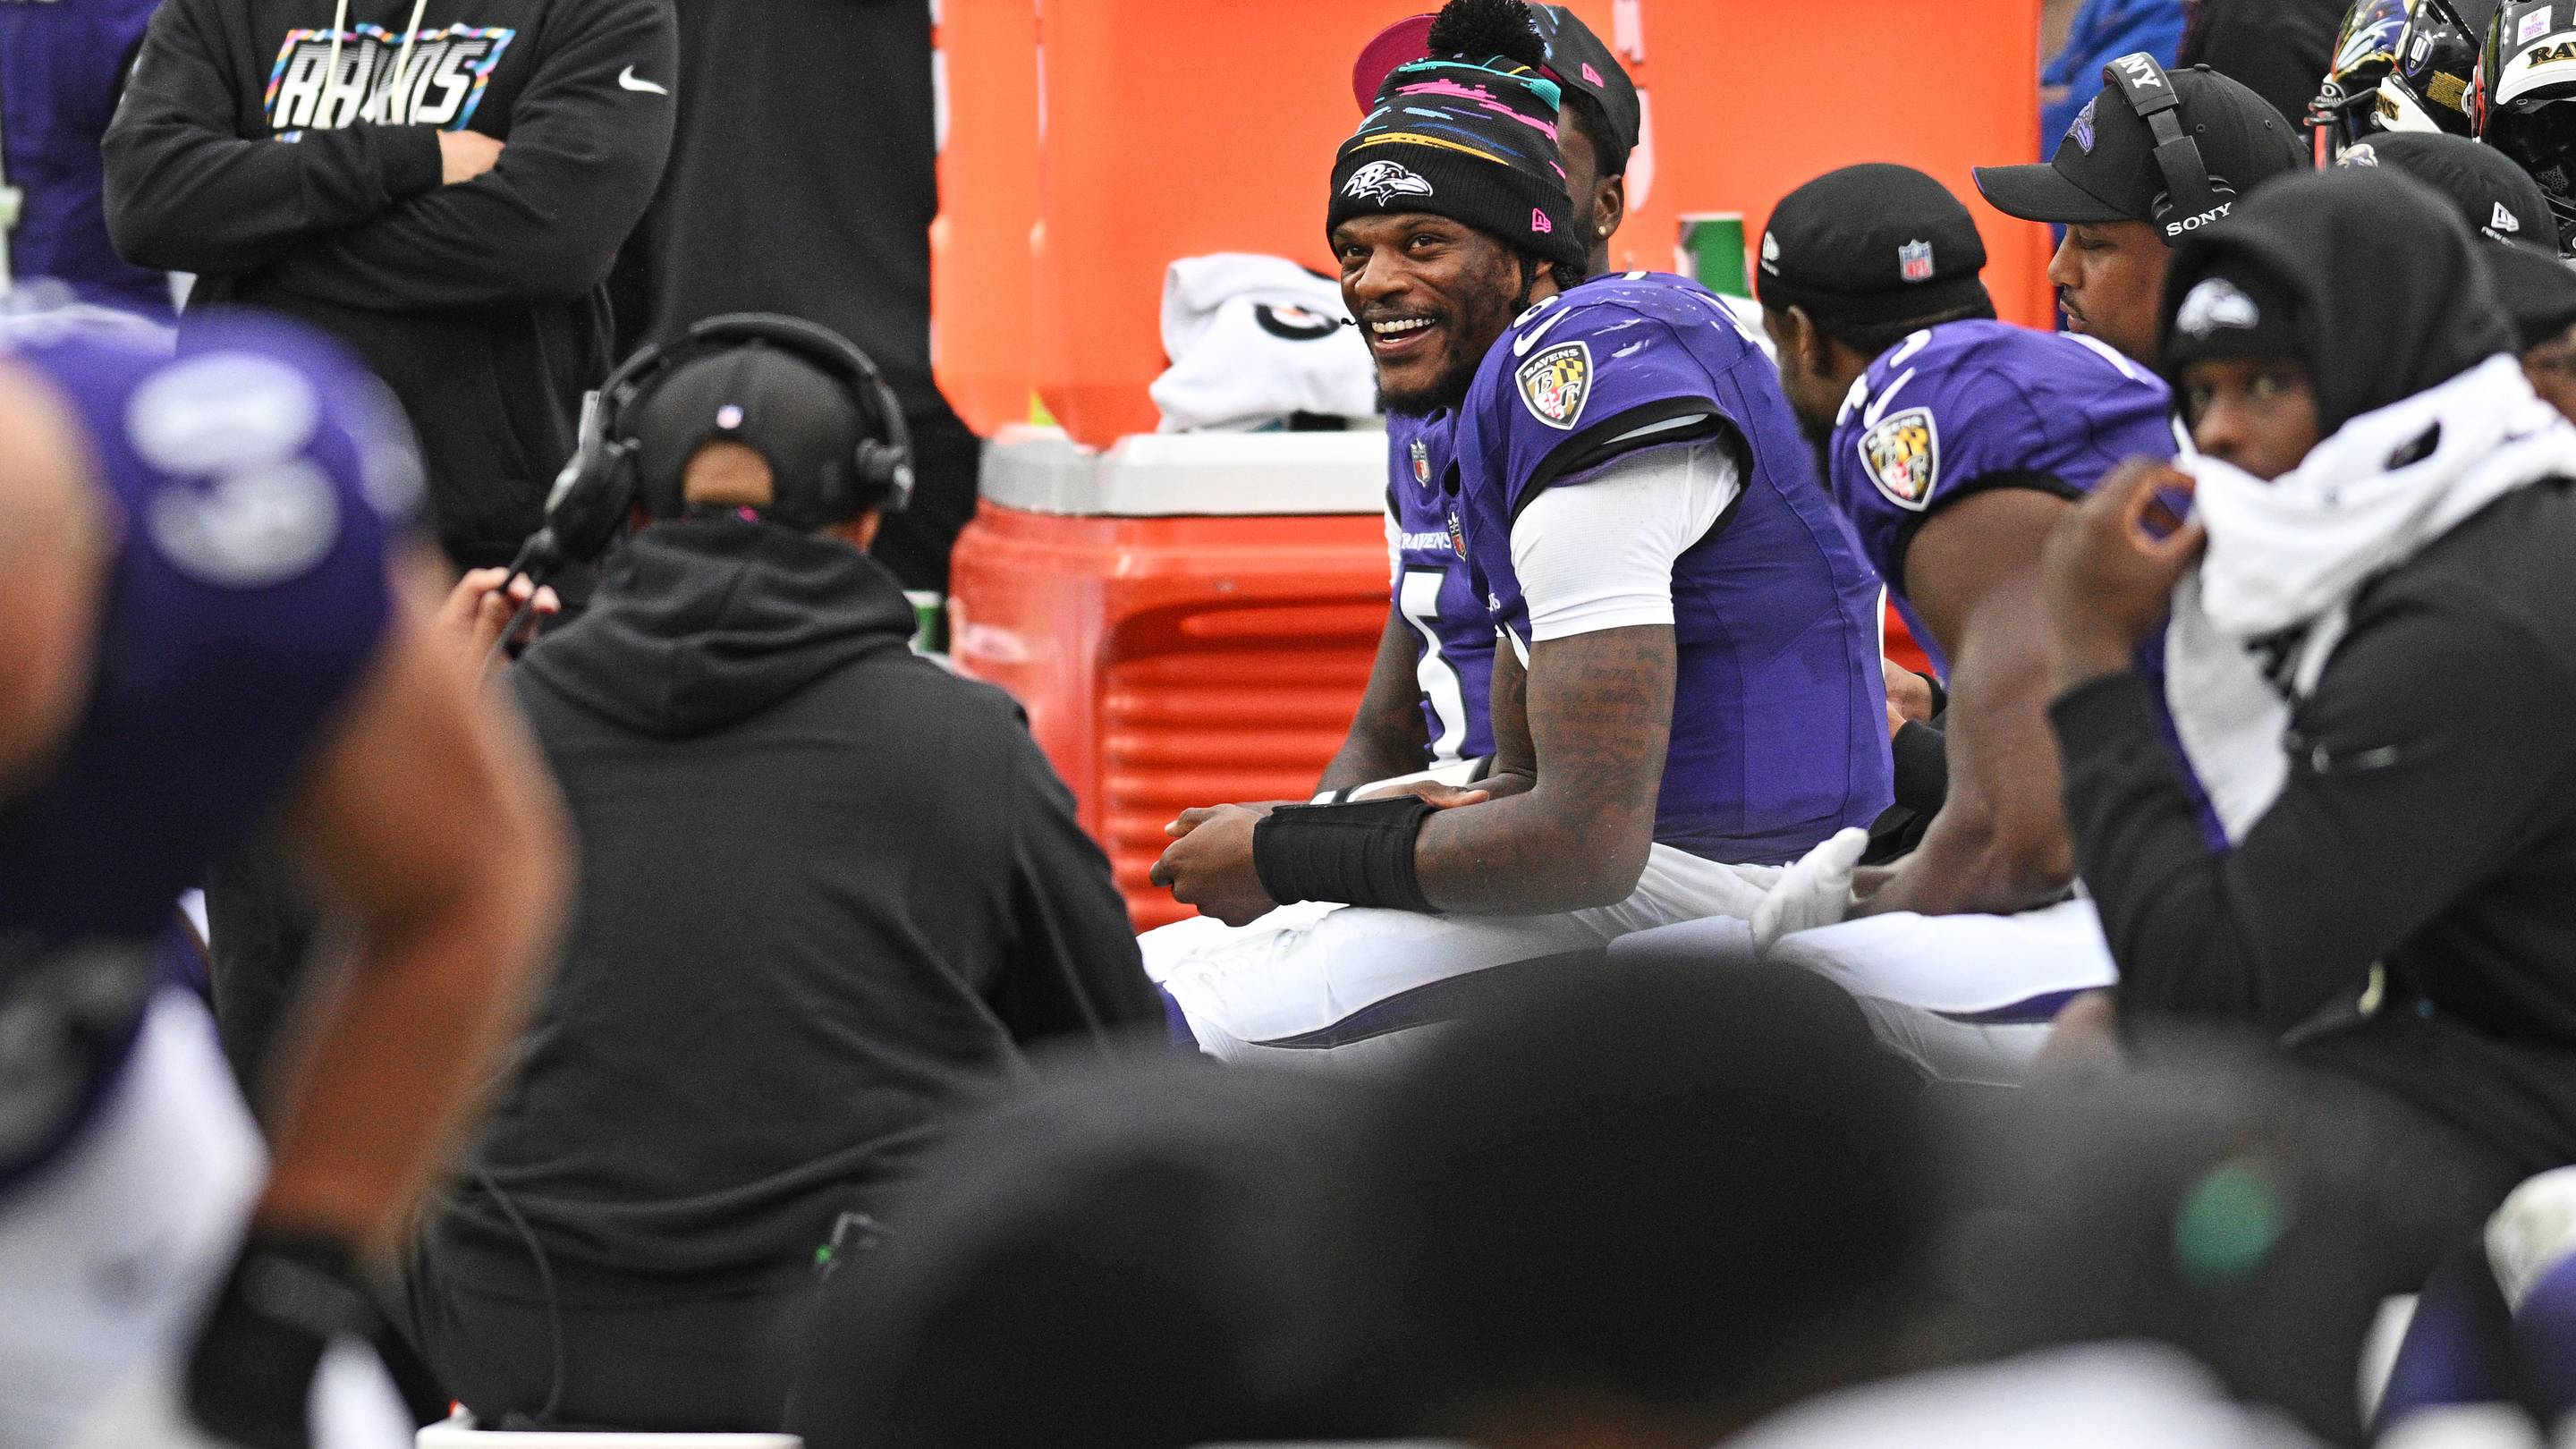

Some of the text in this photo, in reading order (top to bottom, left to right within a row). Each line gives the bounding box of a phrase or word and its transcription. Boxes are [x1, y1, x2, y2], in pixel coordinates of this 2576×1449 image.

[2527, 41, 2576, 69] RA
[2165, 201, 2233, 237] SONY
[1522, 348, 1580, 379] RAVENS
[1401, 531, 1452, 552] RAVENS
